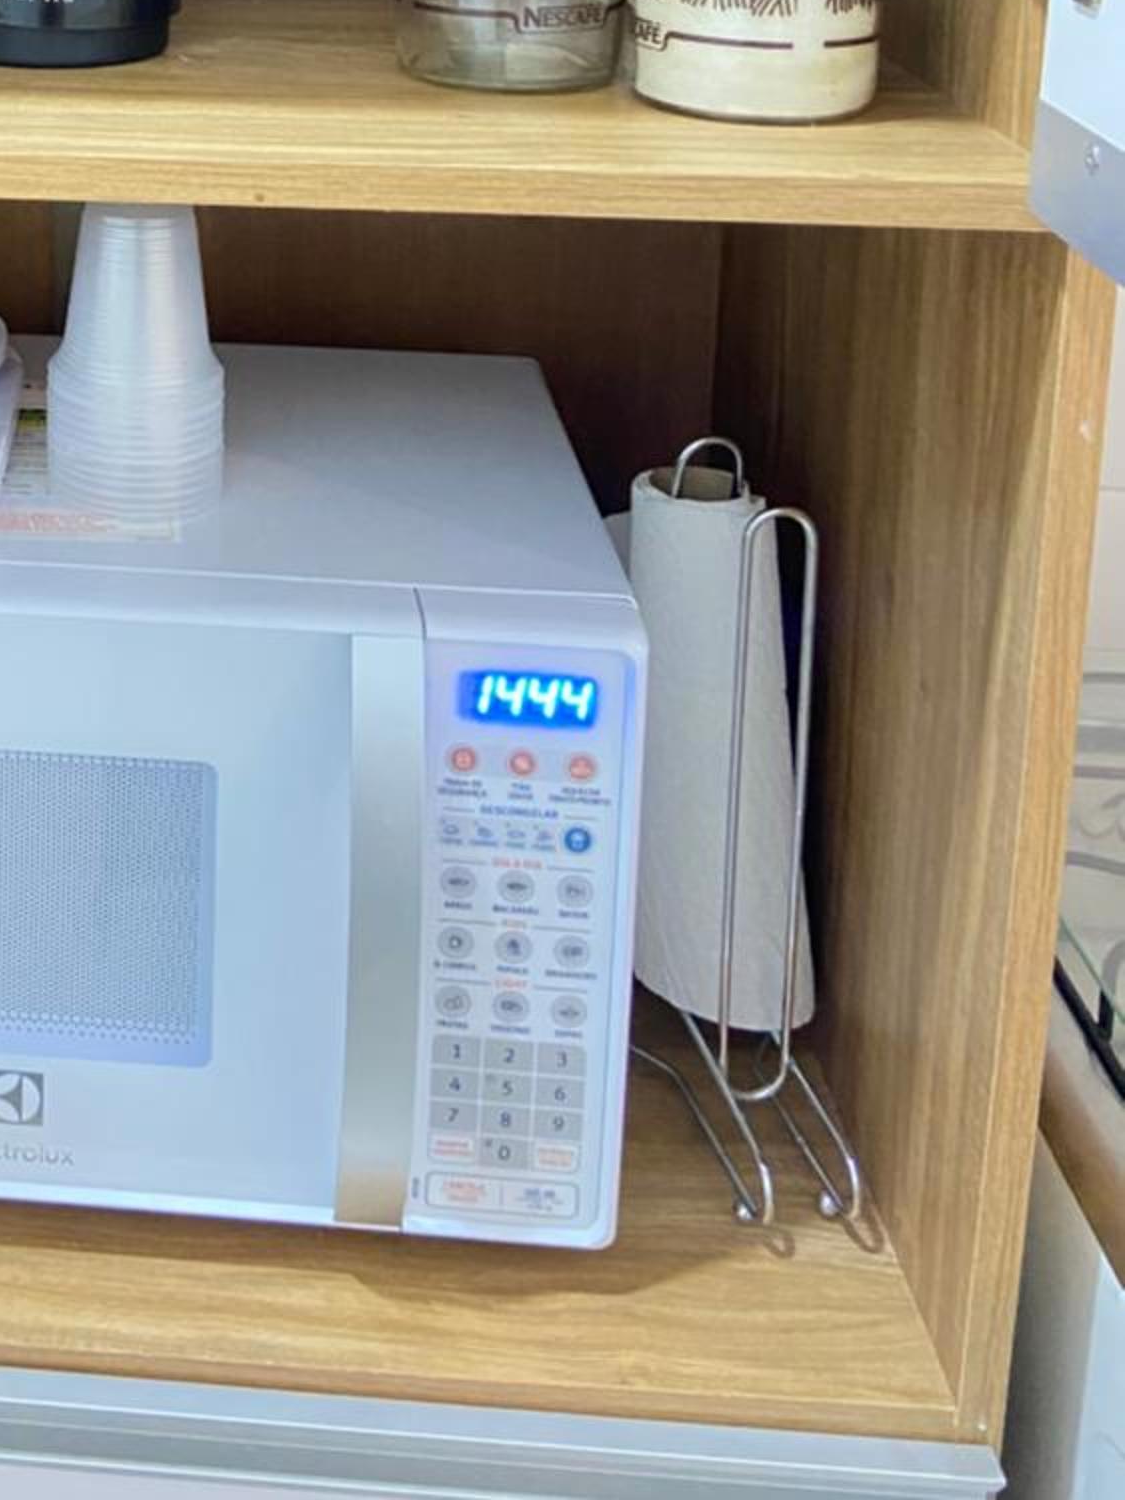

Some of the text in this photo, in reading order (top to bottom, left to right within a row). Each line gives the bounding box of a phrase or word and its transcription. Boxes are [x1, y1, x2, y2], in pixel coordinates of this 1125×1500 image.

[453, 1043, 567, 1068] 1 2 3
[449, 1076, 566, 1102] 4 5 6
[448, 1107, 564, 1131] 7 8 9
[498, 1145, 511, 1161] 0
